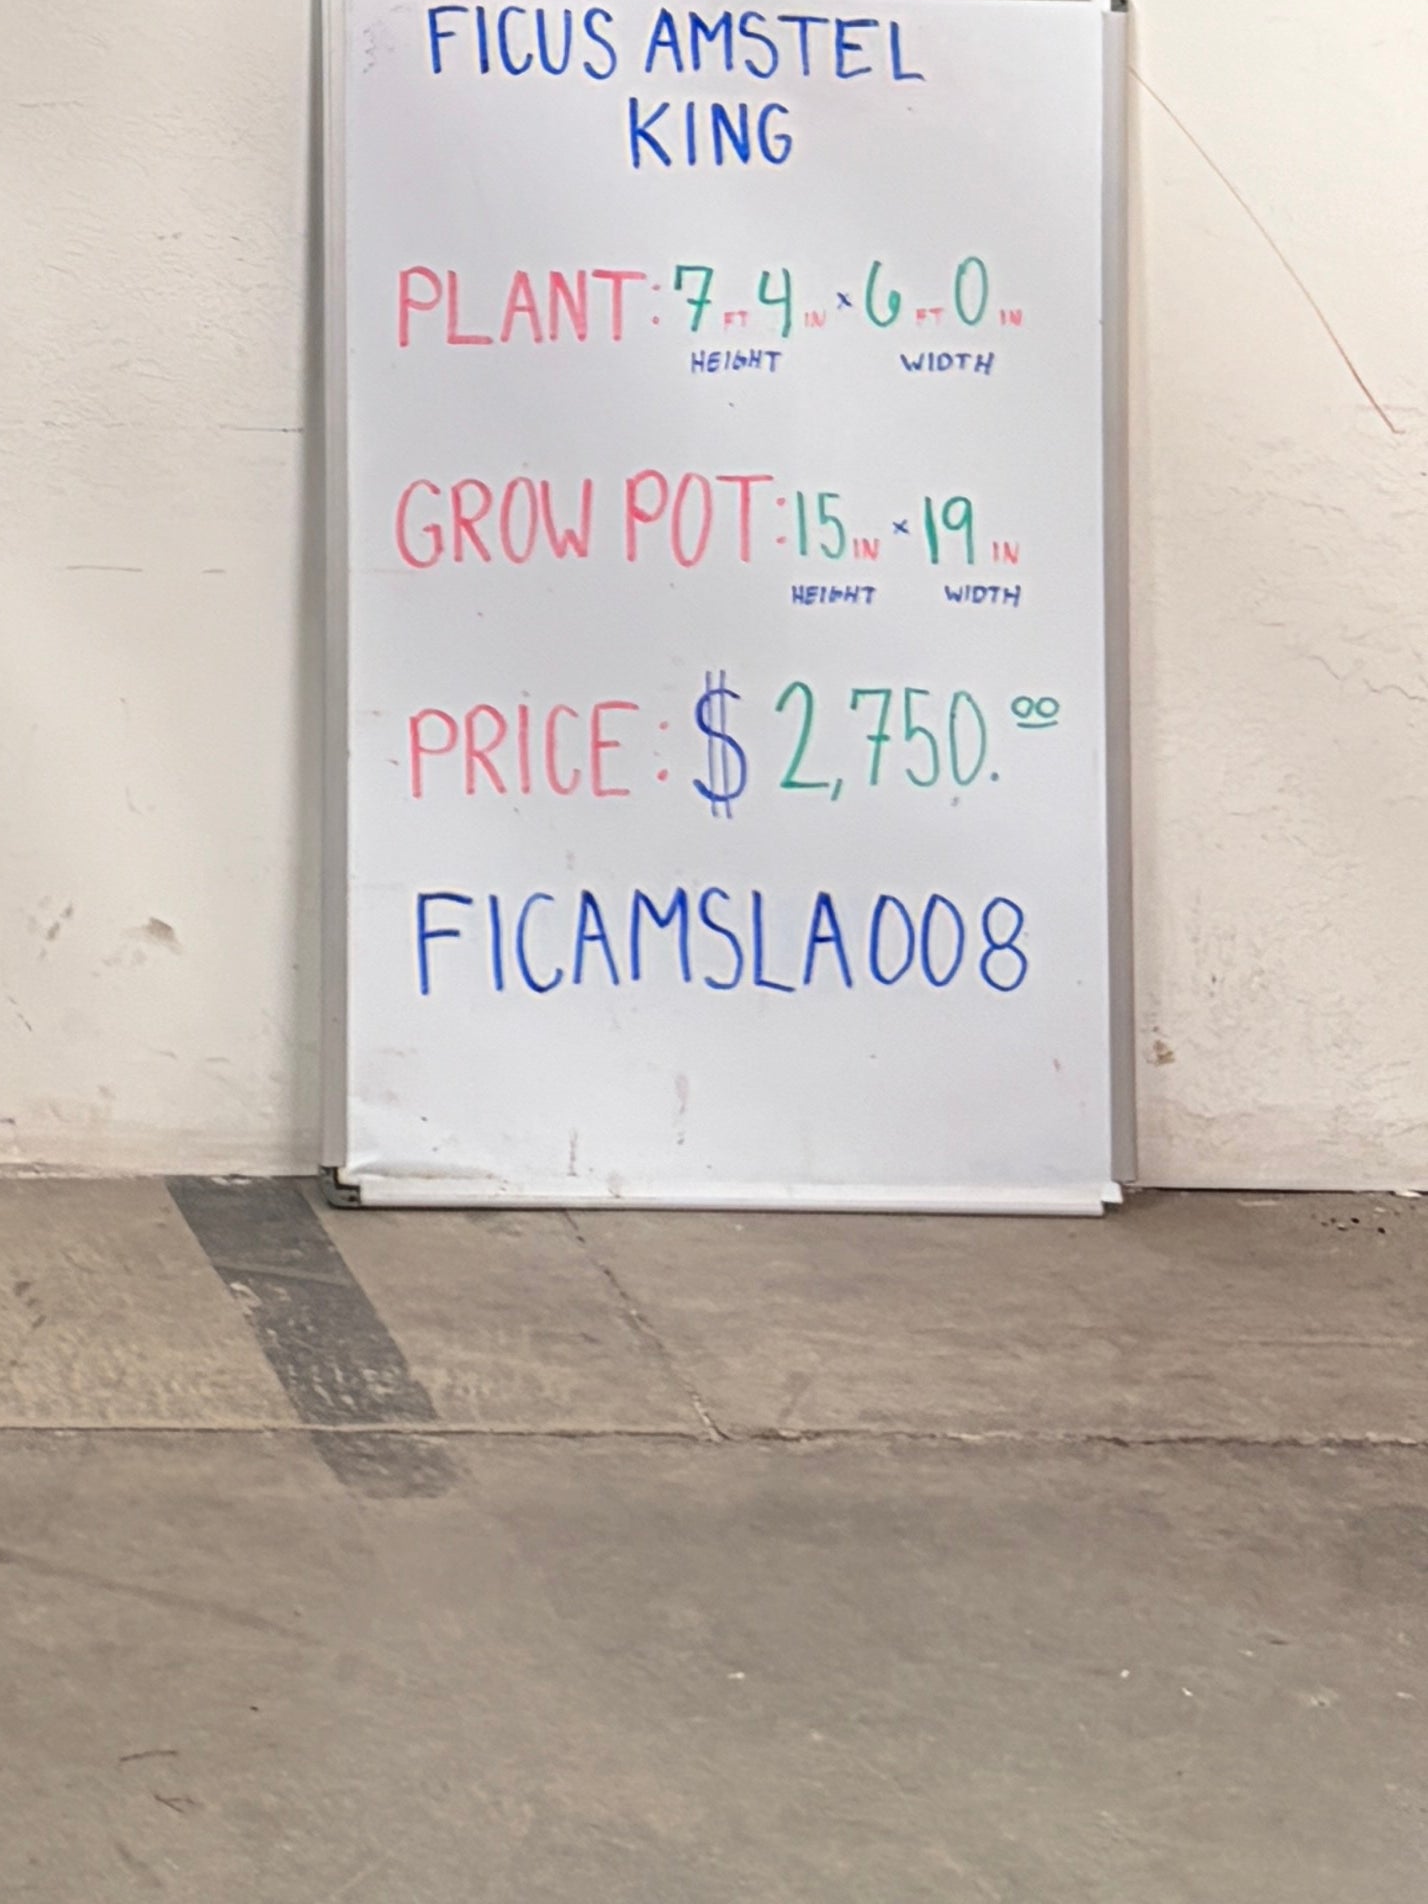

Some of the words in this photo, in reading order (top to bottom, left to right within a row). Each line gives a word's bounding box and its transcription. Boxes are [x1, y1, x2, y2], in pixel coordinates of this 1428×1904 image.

[427, 4, 619, 81] FICUS
[643, 7, 926, 82] AMSTEL
[627, 96, 794, 170] KING
[397, 265, 662, 349] PLANT:
[673, 264, 714, 332] 7
[757, 267, 791, 339] 4
[864, 260, 901, 328] 6
[691, 349, 782, 374] HEIGHT
[900, 352, 996, 375] WIDTH
[395, 476, 595, 570] GROW
[624, 468, 787, 569] POT:
[796, 490, 846, 560] 15
[924, 495, 975, 565] 19
[791, 584, 877, 606] HEIGHT
[944, 584, 1022, 608] WIDTH
[408, 699, 670, 799] PRICE:
[416, 886, 1029, 997] FICAMSLA008
